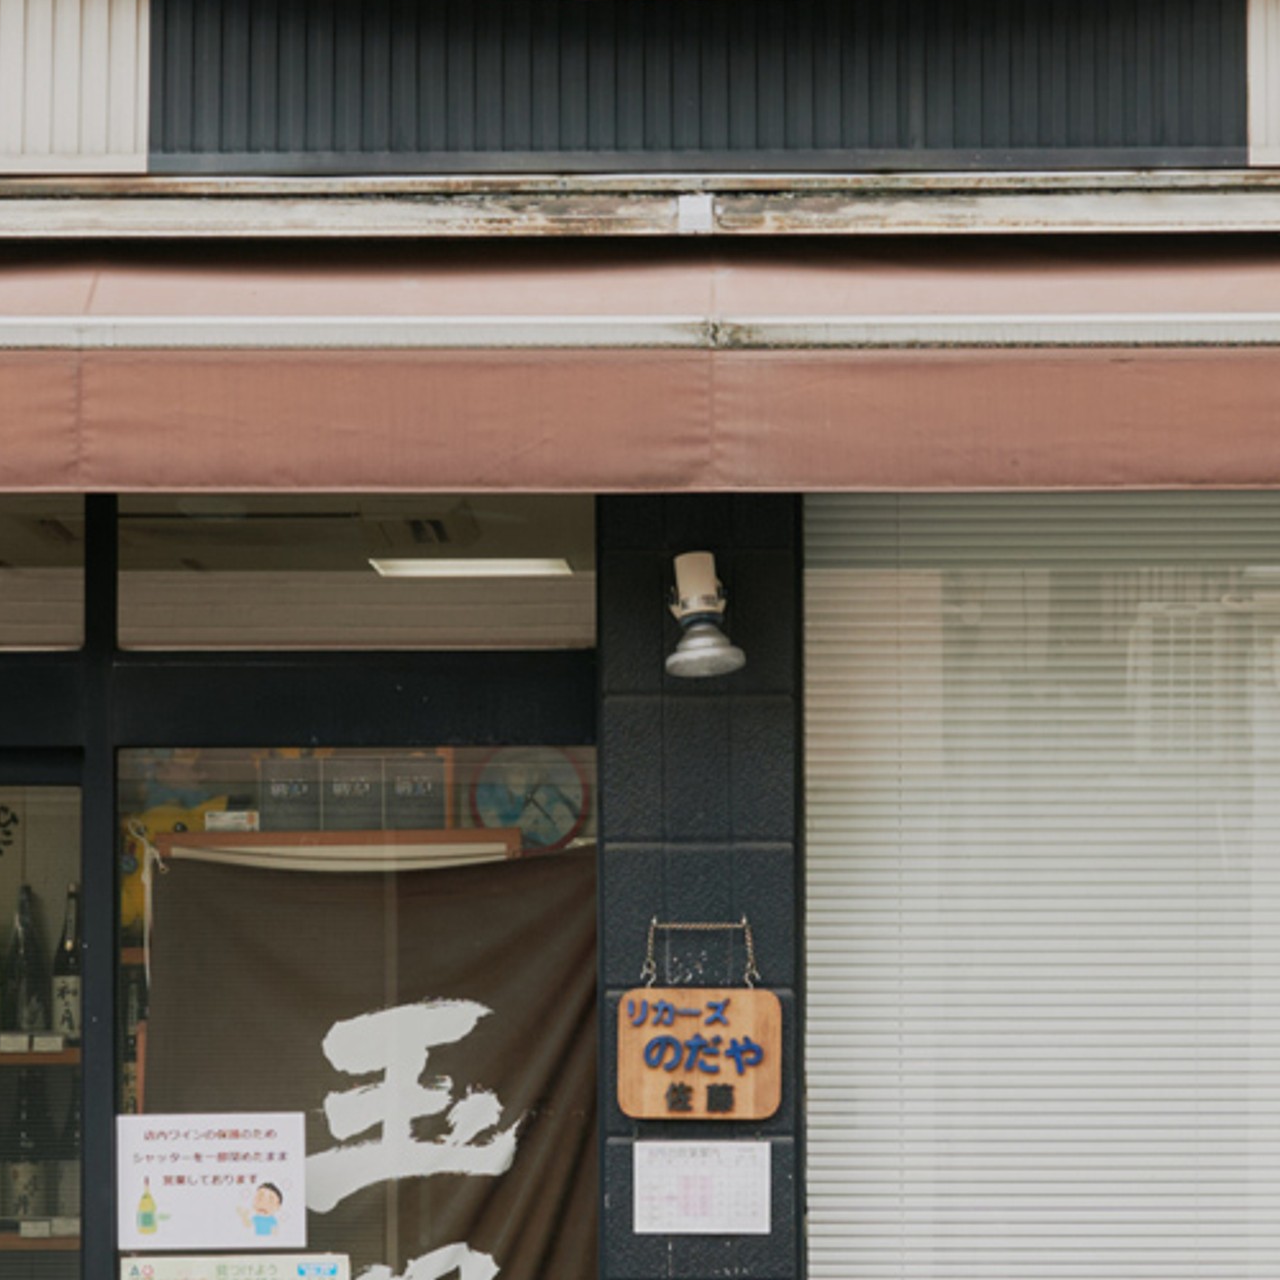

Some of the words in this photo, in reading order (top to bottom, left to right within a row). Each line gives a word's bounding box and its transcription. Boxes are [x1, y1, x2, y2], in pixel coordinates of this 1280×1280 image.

[627, 998, 731, 1027] リカーズ
[643, 1032, 764, 1076] のだや
